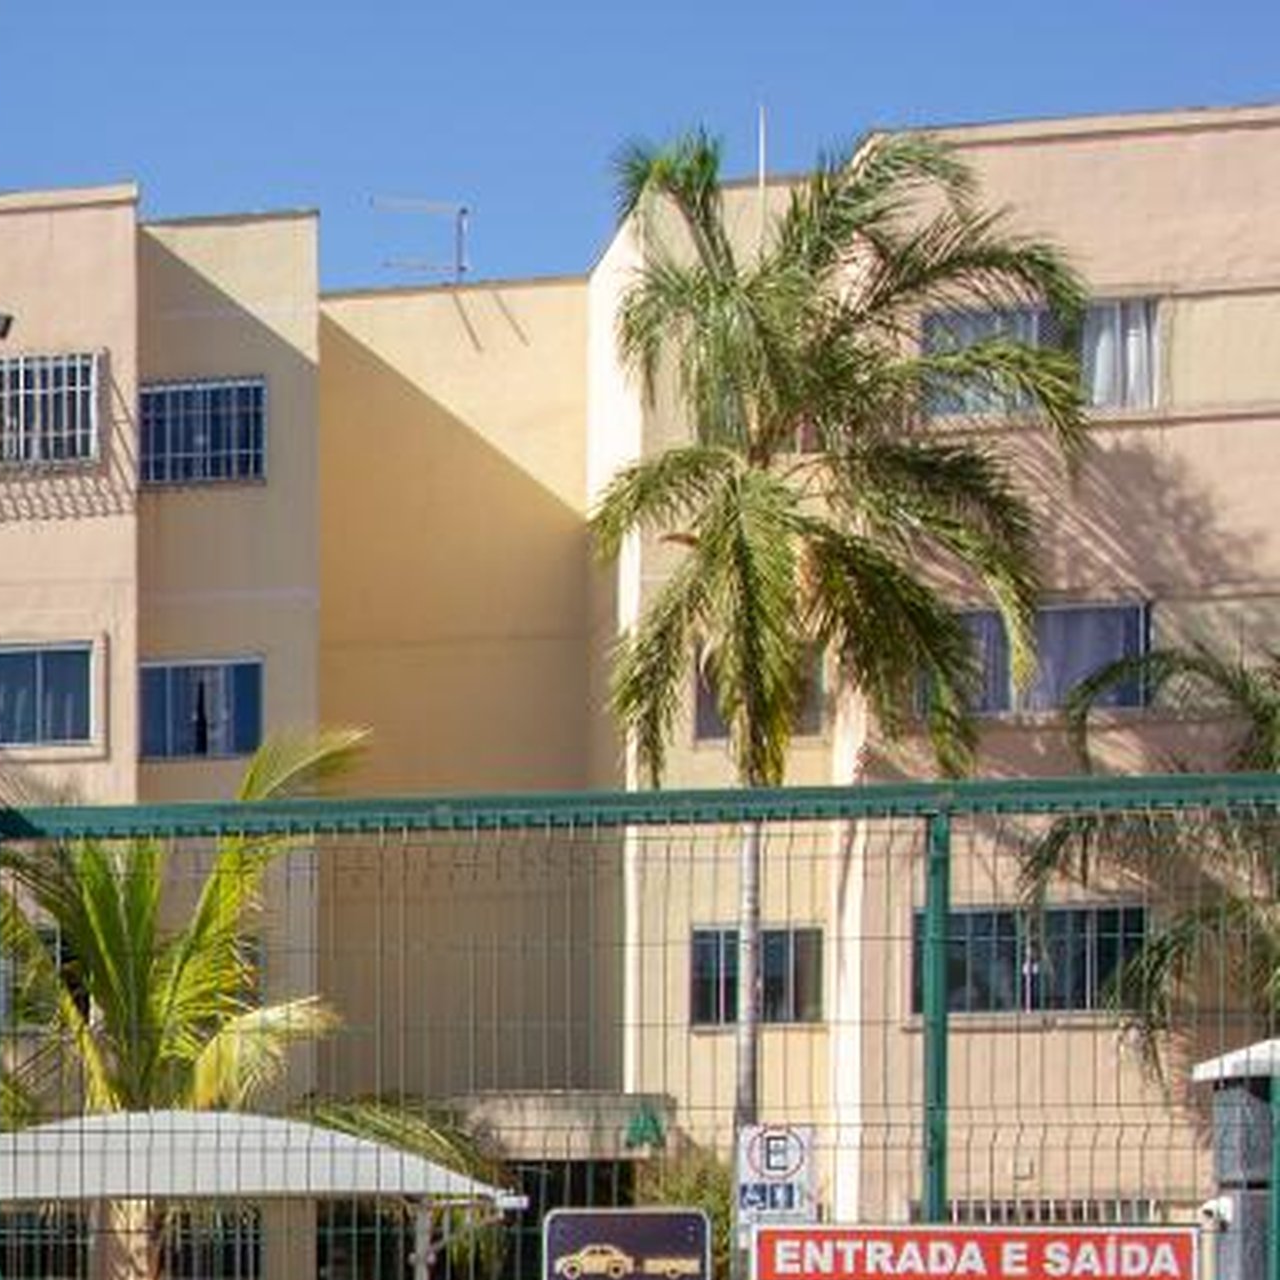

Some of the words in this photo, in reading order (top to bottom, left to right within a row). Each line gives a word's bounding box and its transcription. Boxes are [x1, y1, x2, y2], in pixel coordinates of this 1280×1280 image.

[766, 1135, 788, 1171] E
[773, 1239, 988, 1276] ENTRADA
[1001, 1240, 1029, 1276] E
[1043, 1236, 1180, 1278] SAÍDA
